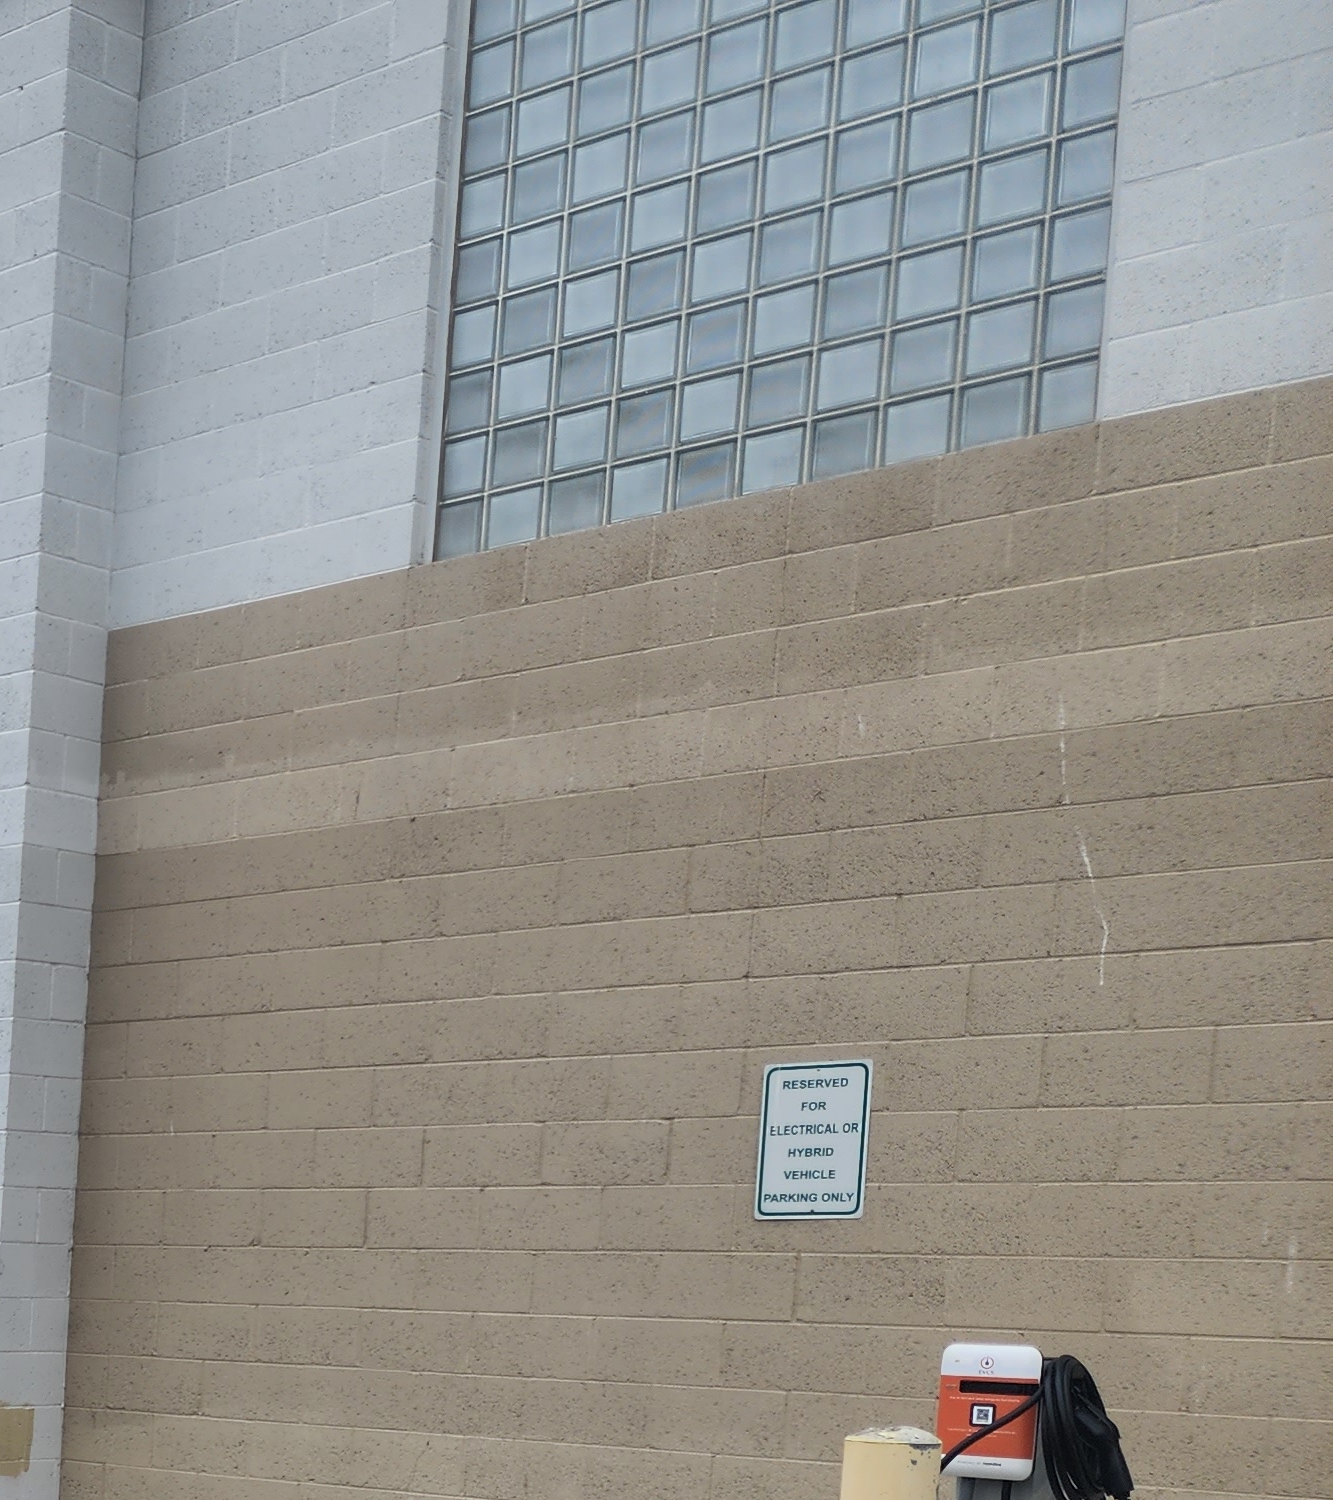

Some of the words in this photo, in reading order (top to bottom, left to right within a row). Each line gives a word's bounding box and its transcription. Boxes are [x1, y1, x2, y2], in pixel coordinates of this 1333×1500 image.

[782, 1077, 849, 1090] RESERVED
[800, 1101, 827, 1112] FOR
[769, 1123, 839, 1137] ELECTRICAL
[842, 1122, 859, 1133] OR
[787, 1147, 834, 1158] HYBRID
[783, 1169, 836, 1180] VEHICLE
[763, 1192, 818, 1203] PARKING
[821, 1192, 855, 1203] ONLY
